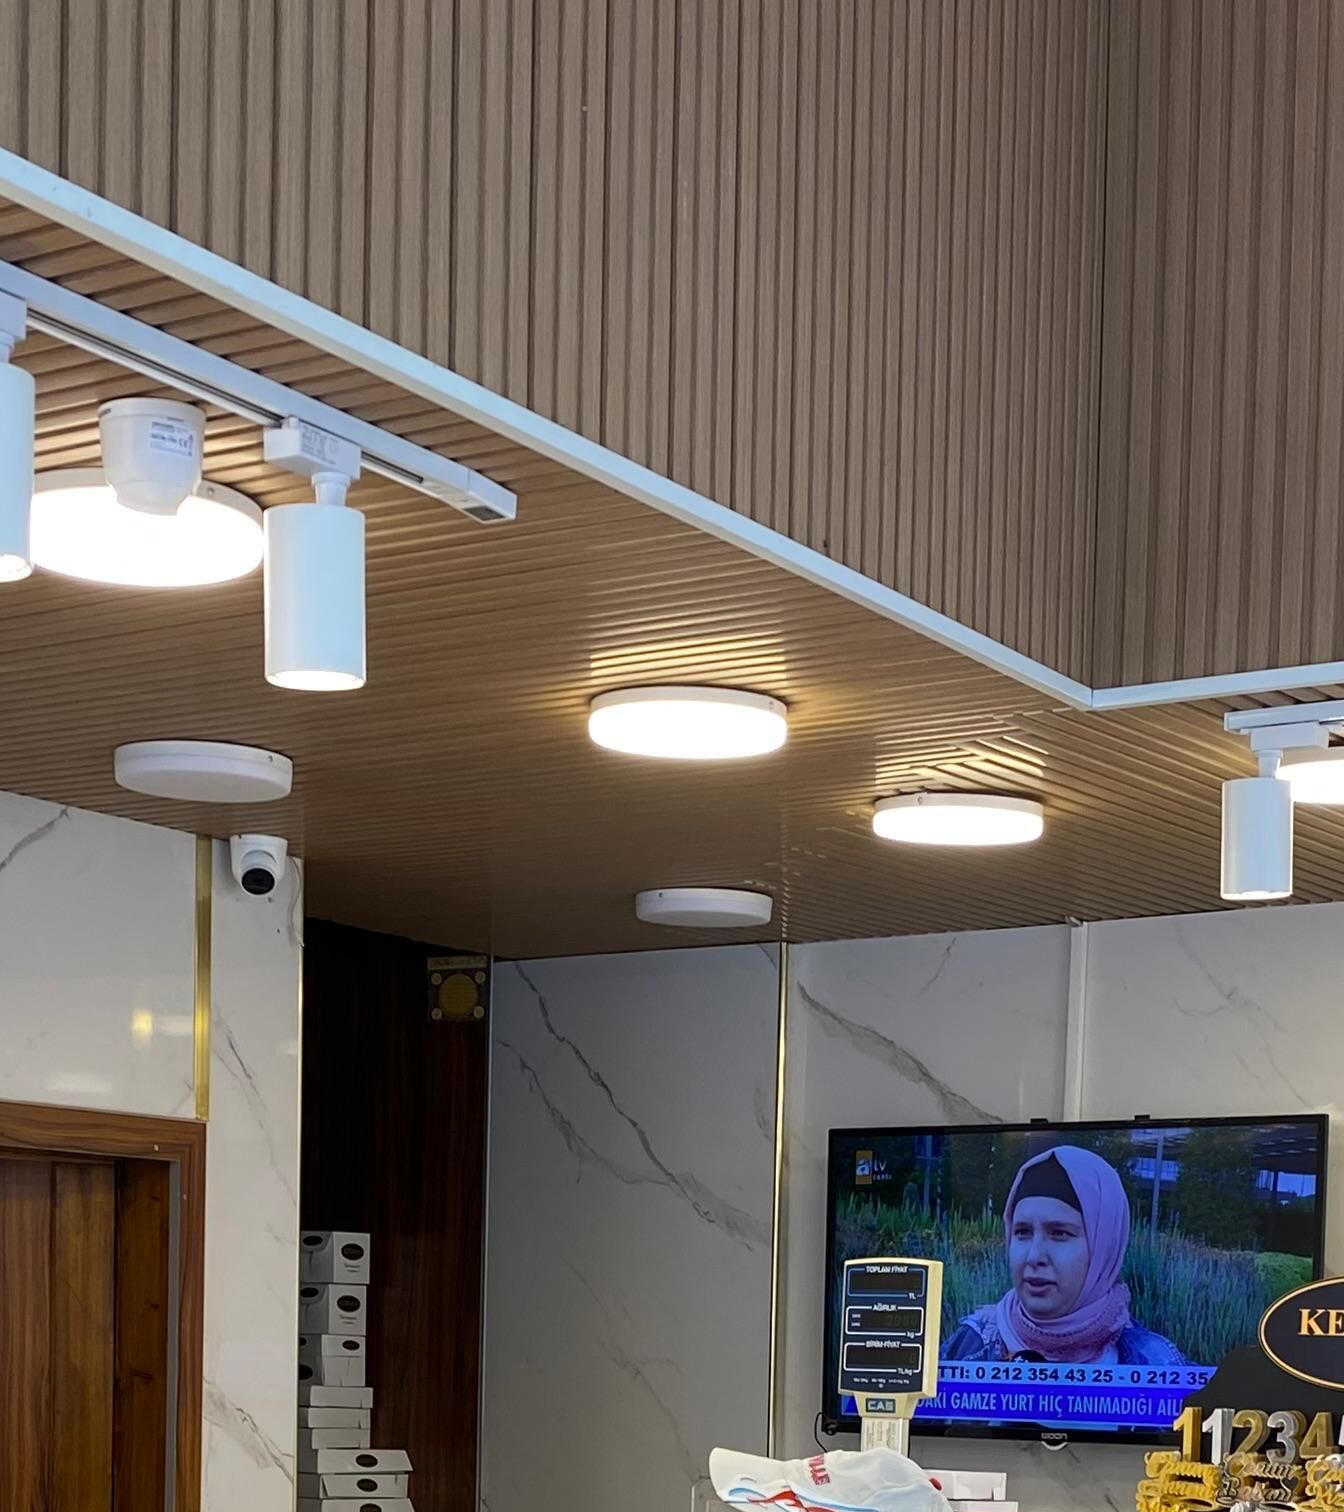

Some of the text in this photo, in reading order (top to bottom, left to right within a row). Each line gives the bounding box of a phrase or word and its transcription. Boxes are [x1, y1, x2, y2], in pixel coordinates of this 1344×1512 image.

[975, 1366, 986, 1380] 0
[999, 1366, 1022, 1380] 212
[1028, 1367, 1060, 1381] 354
[1064, 1368, 1086, 1382] 43
[1091, 1369, 1113, 1383] 25
[1130, 1370, 1141, 1384] 0
[1147, 1371, 1181, 1385] 212
[868, 1400, 894, 1411] CAS
[951, 1392, 997, 1411] GAMZE
[1001, 1393, 1033, 1412] YURT
[1039, 1392, 1063, 1417] HİÇ
[1067, 1393, 1152, 1416] TANIMADIĞI
